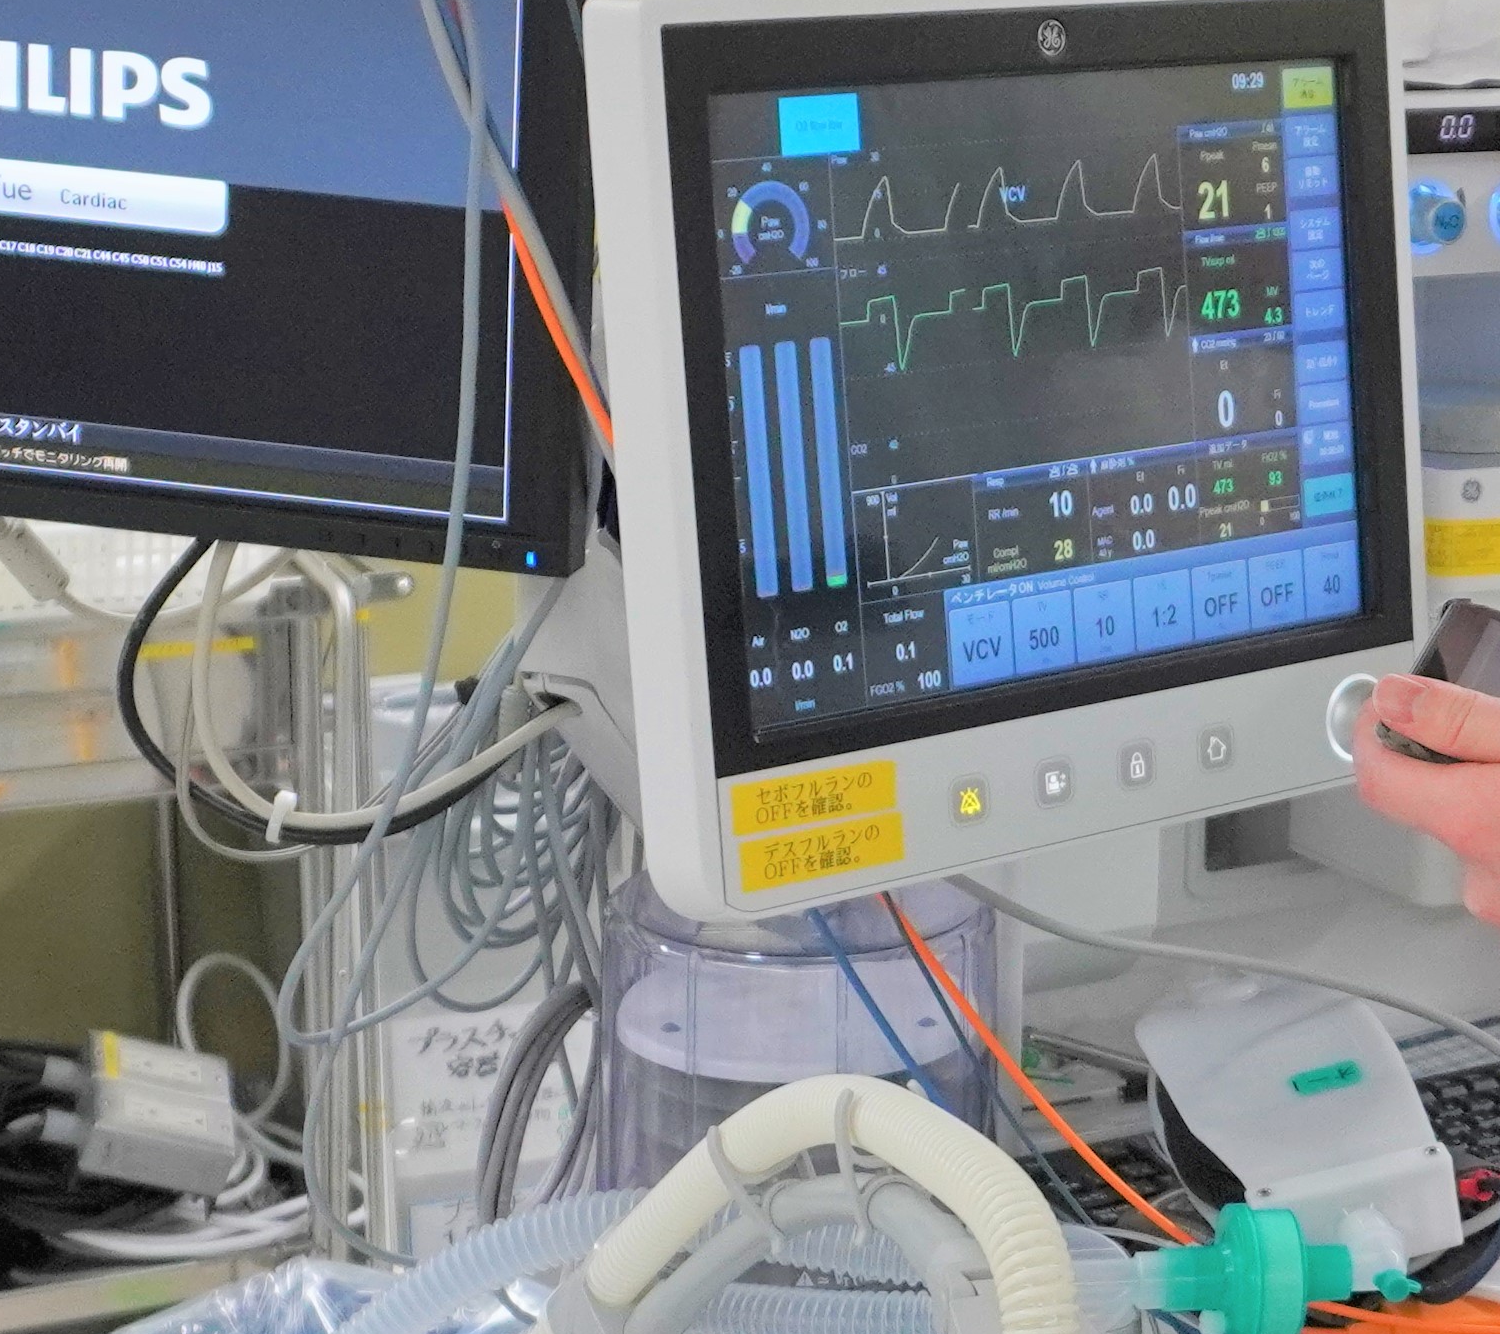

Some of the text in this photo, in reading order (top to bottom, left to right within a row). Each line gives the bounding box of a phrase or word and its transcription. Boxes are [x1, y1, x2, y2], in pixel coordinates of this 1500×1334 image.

[1232, 72, 1264, 89] 09:29
[1440, 114, 1475, 140] 0.0
[1262, 157, 1269, 172] 6
[999, 186, 1026, 203] VCV
[1256, 182, 1277, 193] PEEP
[60, 188, 127, 211] Cardiac
[1198, 180, 1229, 219] 21
[1264, 203, 1271, 219] 1
[761, 217, 780, 228] Paw
[1201, 289, 1241, 319] 473
[1264, 307, 1283, 324] 4.3
[1217, 390, 1235, 428] 0
[1275, 410, 1283, 426] 0
[851, 444, 867, 454] CO2
[1213, 479, 1234, 494] 473
[1268, 471, 1282, 485] 93
[1050, 491, 1073, 517] 10
[1130, 494, 1152, 515] 0.0
[1168, 483, 1196, 511] 0.0
[1092, 505, 1114, 517] Agent
[1133, 529, 1155, 551] 0.0
[1220, 523, 1232, 538] 21
[943, 552, 970, 565] cmH2O
[993, 546, 1019, 559] Compl
[1054, 539, 1073, 561] 28
[951, 578, 1034, 605] ベンチレータON
[1324, 574, 1340, 594] 40
[1204, 593, 1238, 617] OFF
[1261, 583, 1293, 607] OFF
[883, 608, 924, 624] Total Flow
[1153, 605, 1177, 628] 1:2
[790, 628, 810, 641] N2O
[835, 621, 848, 633] O2
[1096, 616, 1114, 638] 10
[751, 635, 766, 648] Air
[1029, 626, 1059, 651] 500
[896, 641, 916, 661] 0.1
[963, 636, 1001, 663] VCV
[791, 660, 814, 681] 0.0
[833, 652, 854, 673] 0.1
[750, 667, 772, 688] 0.0
[870, 683, 896, 696] FGO2
[917, 670, 941, 690] 100
[756, 772, 873, 806] セボフルランの
[756, 793, 852, 825] OFFを確認。
[764, 824, 880, 862] デスフルランの
[764, 847, 860, 880] OFFを確認。
